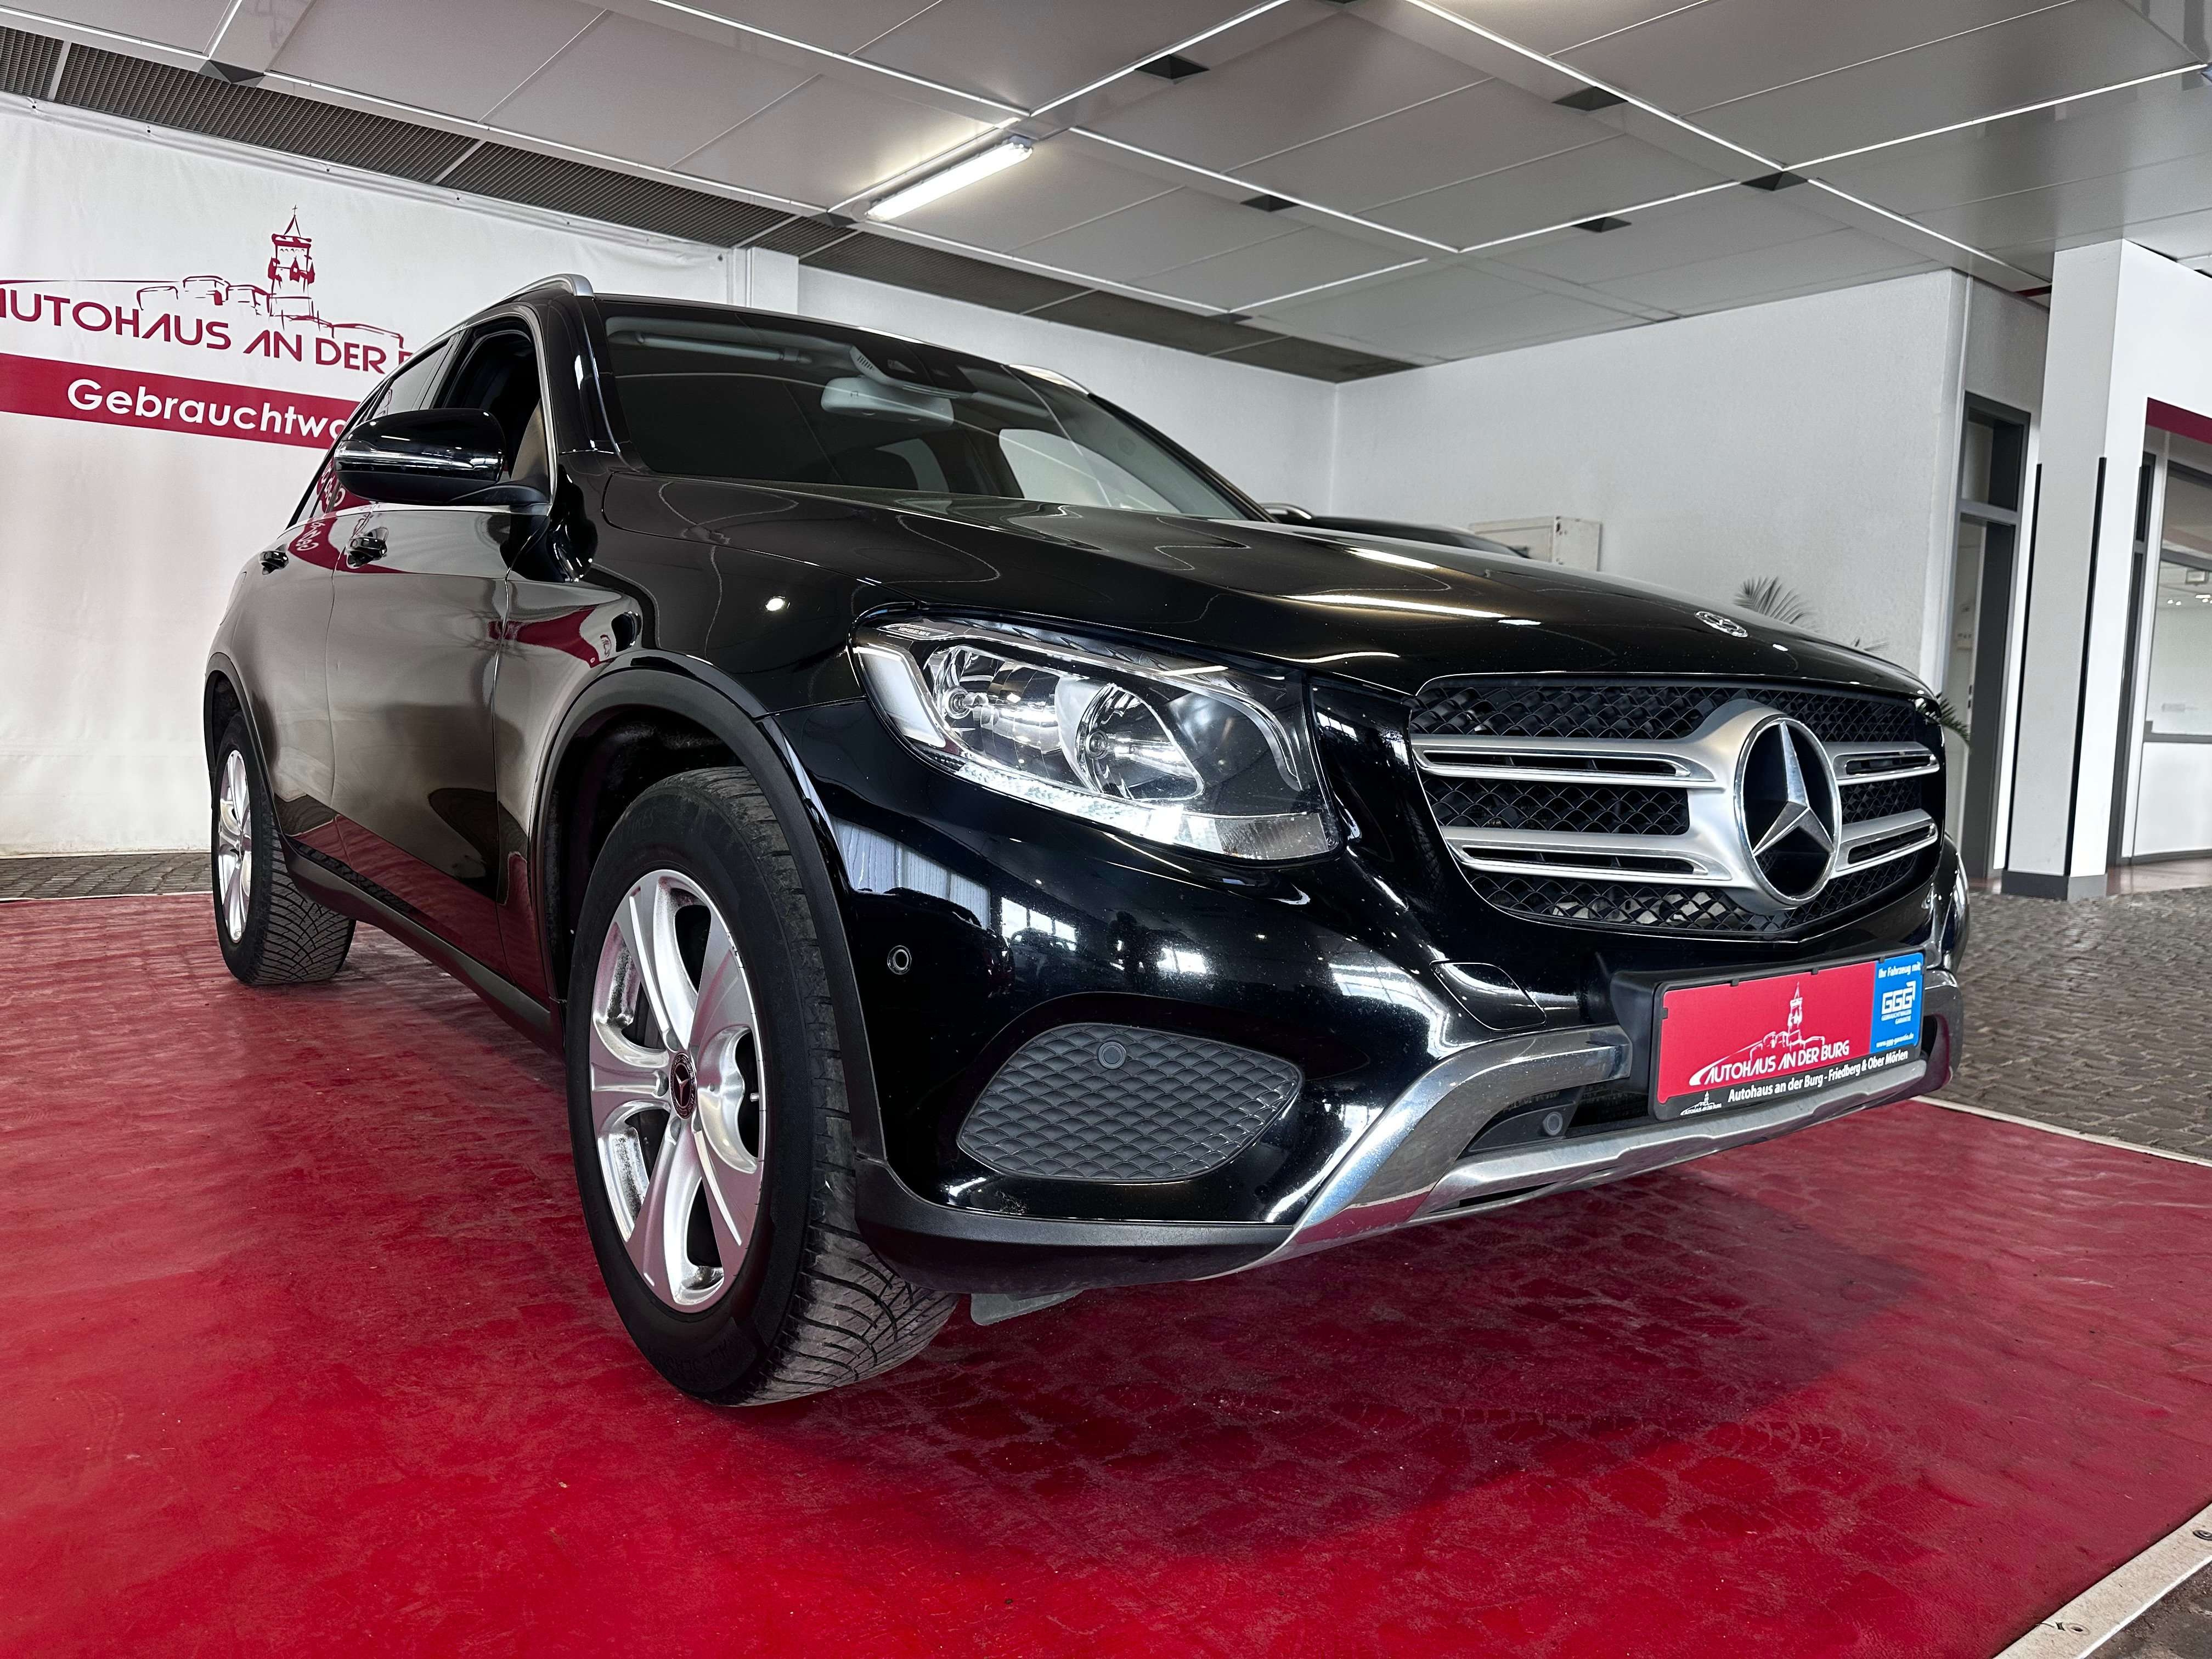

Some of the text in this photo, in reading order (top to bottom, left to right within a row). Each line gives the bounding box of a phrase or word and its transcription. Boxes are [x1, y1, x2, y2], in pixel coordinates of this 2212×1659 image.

[0, 288, 231, 350] UTOHAUS
[242, 329, 302, 362] AN
[315, 337, 386, 374] DER
[1881, 984, 1915, 1014] GGG
[1704, 1040, 1850, 1085] AUTOHAUS AN DER BURG
[1728, 1085, 1773, 1103] Autohaus
[1774, 1082, 1786, 1092] an
[1788, 1077, 1804, 1091] der
[1804, 1074, 1824, 1088] Burg
[1828, 1063, 1861, 1082] Friedberg
[1861, 1059, 1867, 1071] &
[1867, 1057, 1884, 1069] Ober
[1885, 1048, 1908, 1065] Mörlen
